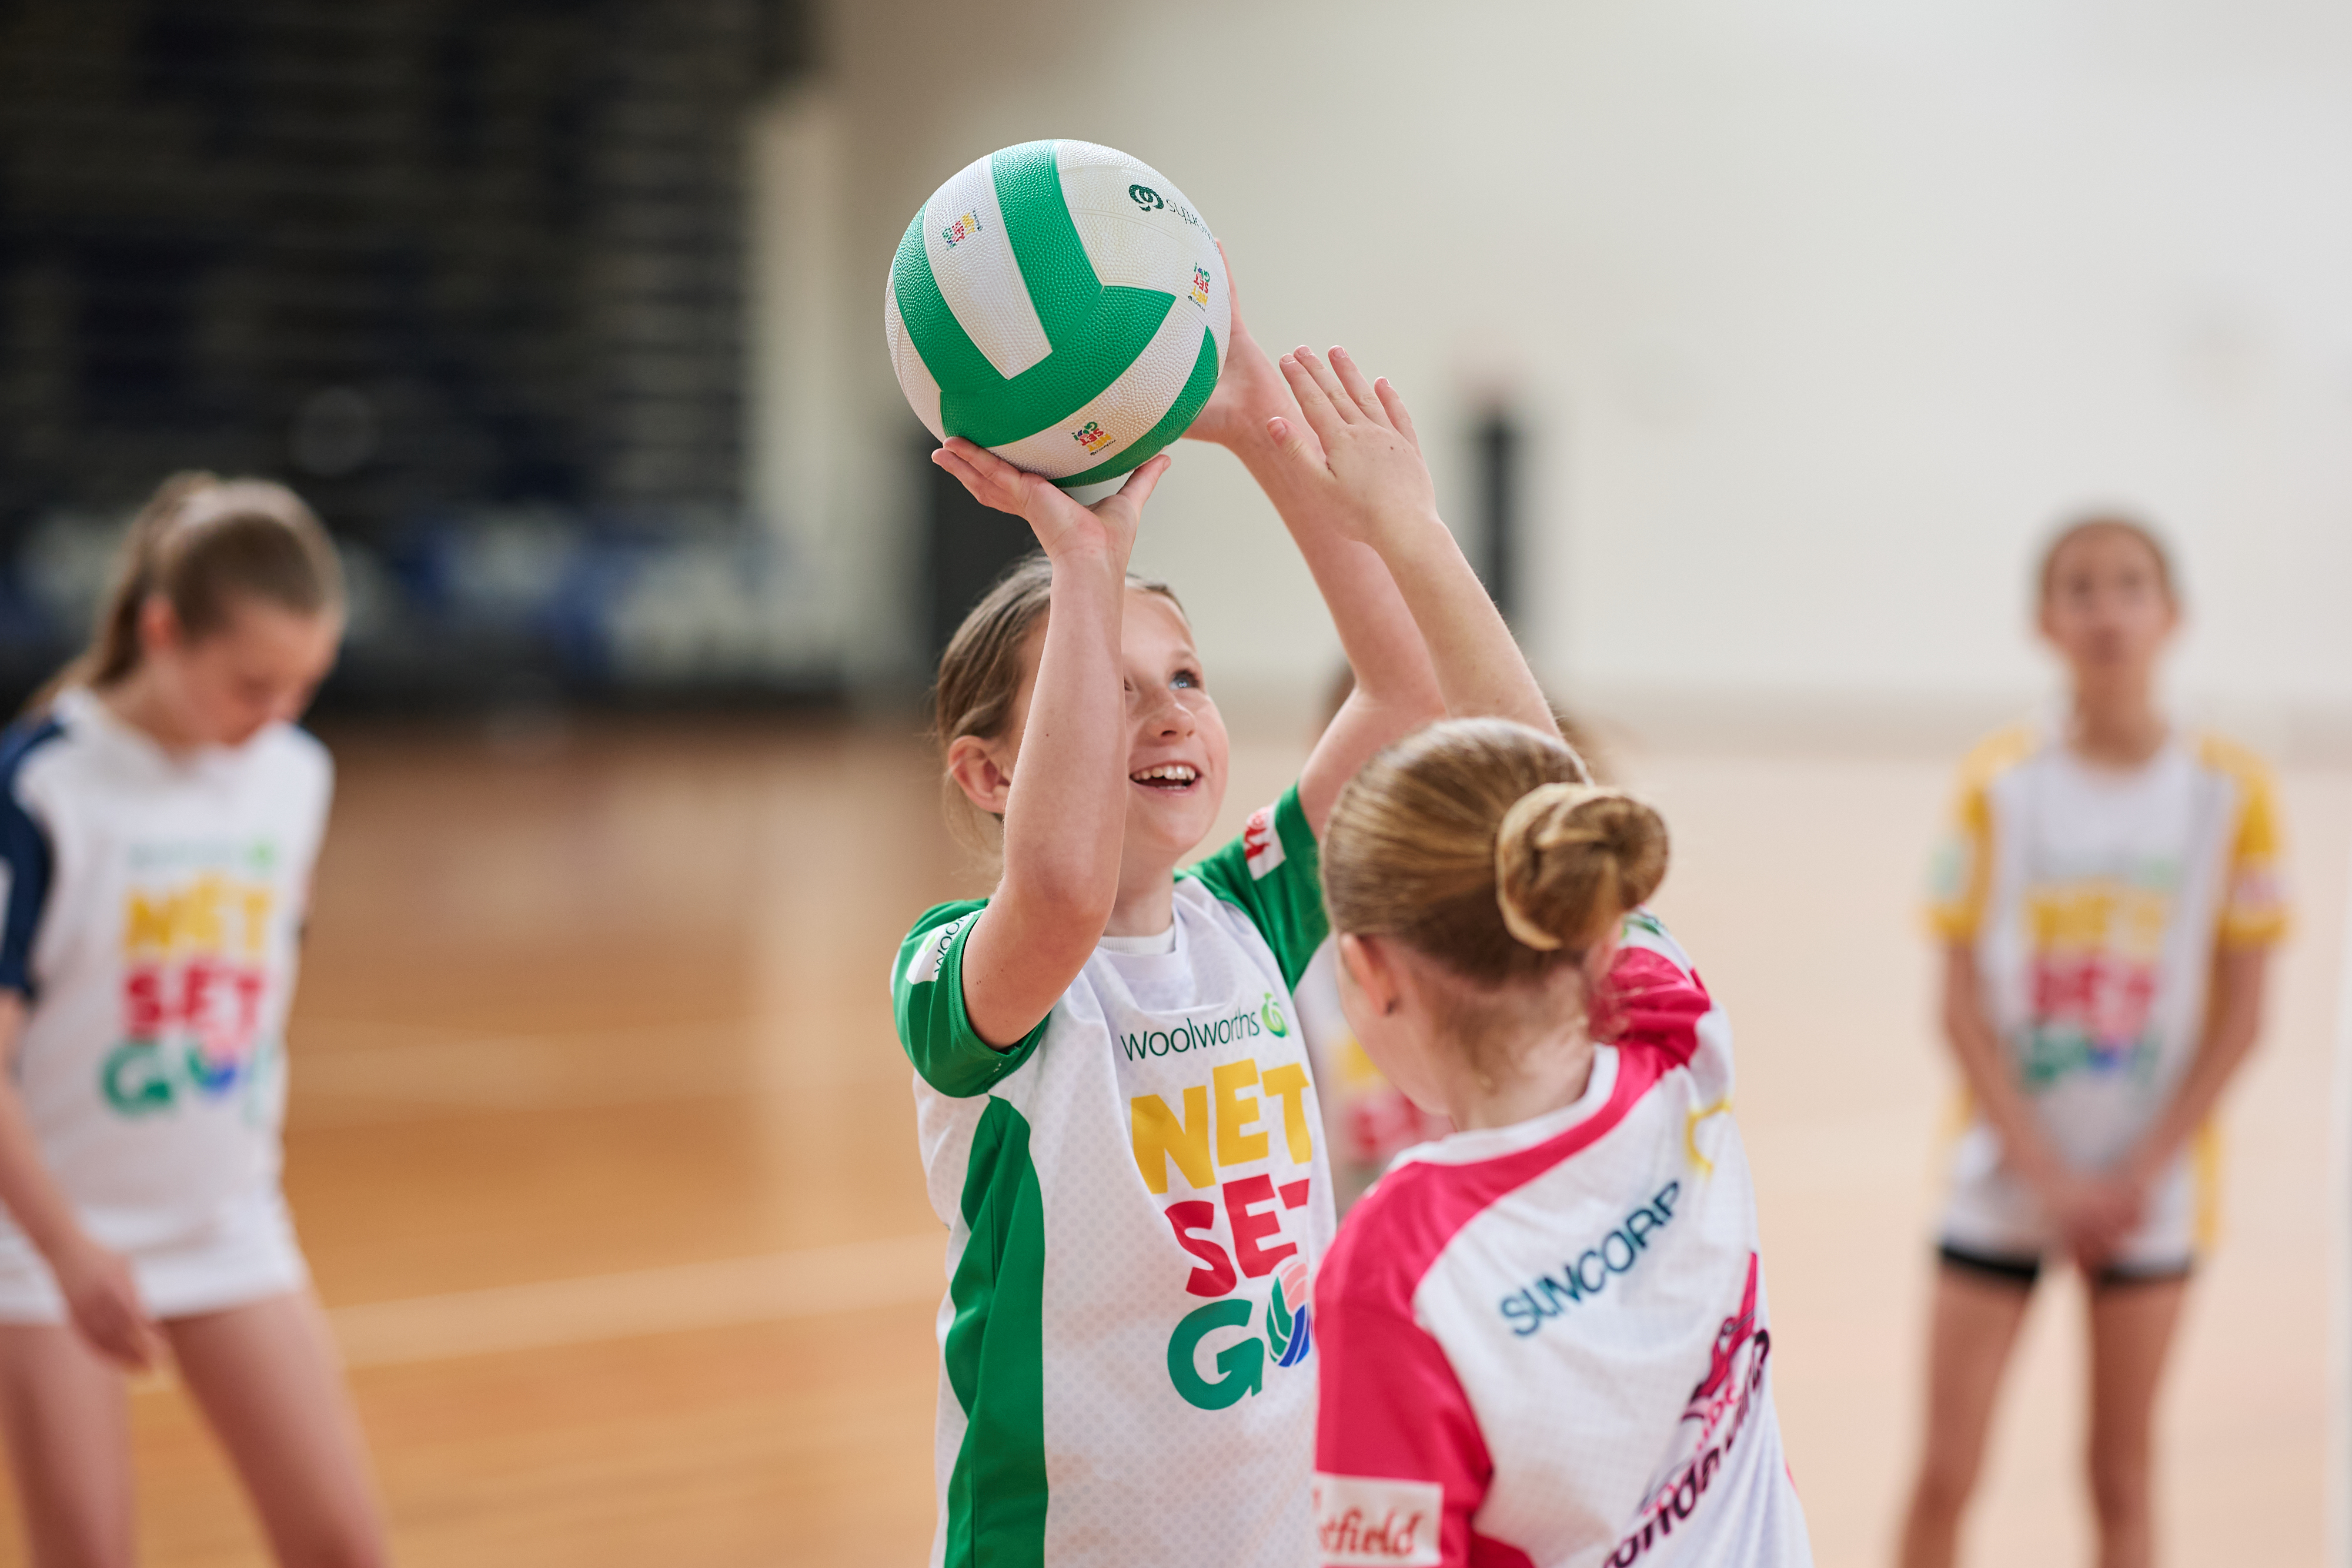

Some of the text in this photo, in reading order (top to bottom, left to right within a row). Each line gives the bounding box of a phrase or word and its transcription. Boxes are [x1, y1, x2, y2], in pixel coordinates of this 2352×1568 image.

[952, 220, 965, 242] SET
[1193, 273, 1209, 294] SET
[1191, 285, 1208, 306] NET
[1080, 428, 1104, 446] SET
[1087, 433, 1112, 452] NET
[1130, 1058, 1312, 1195] NET
[1501, 1179, 1680, 1338] SUNCORP
